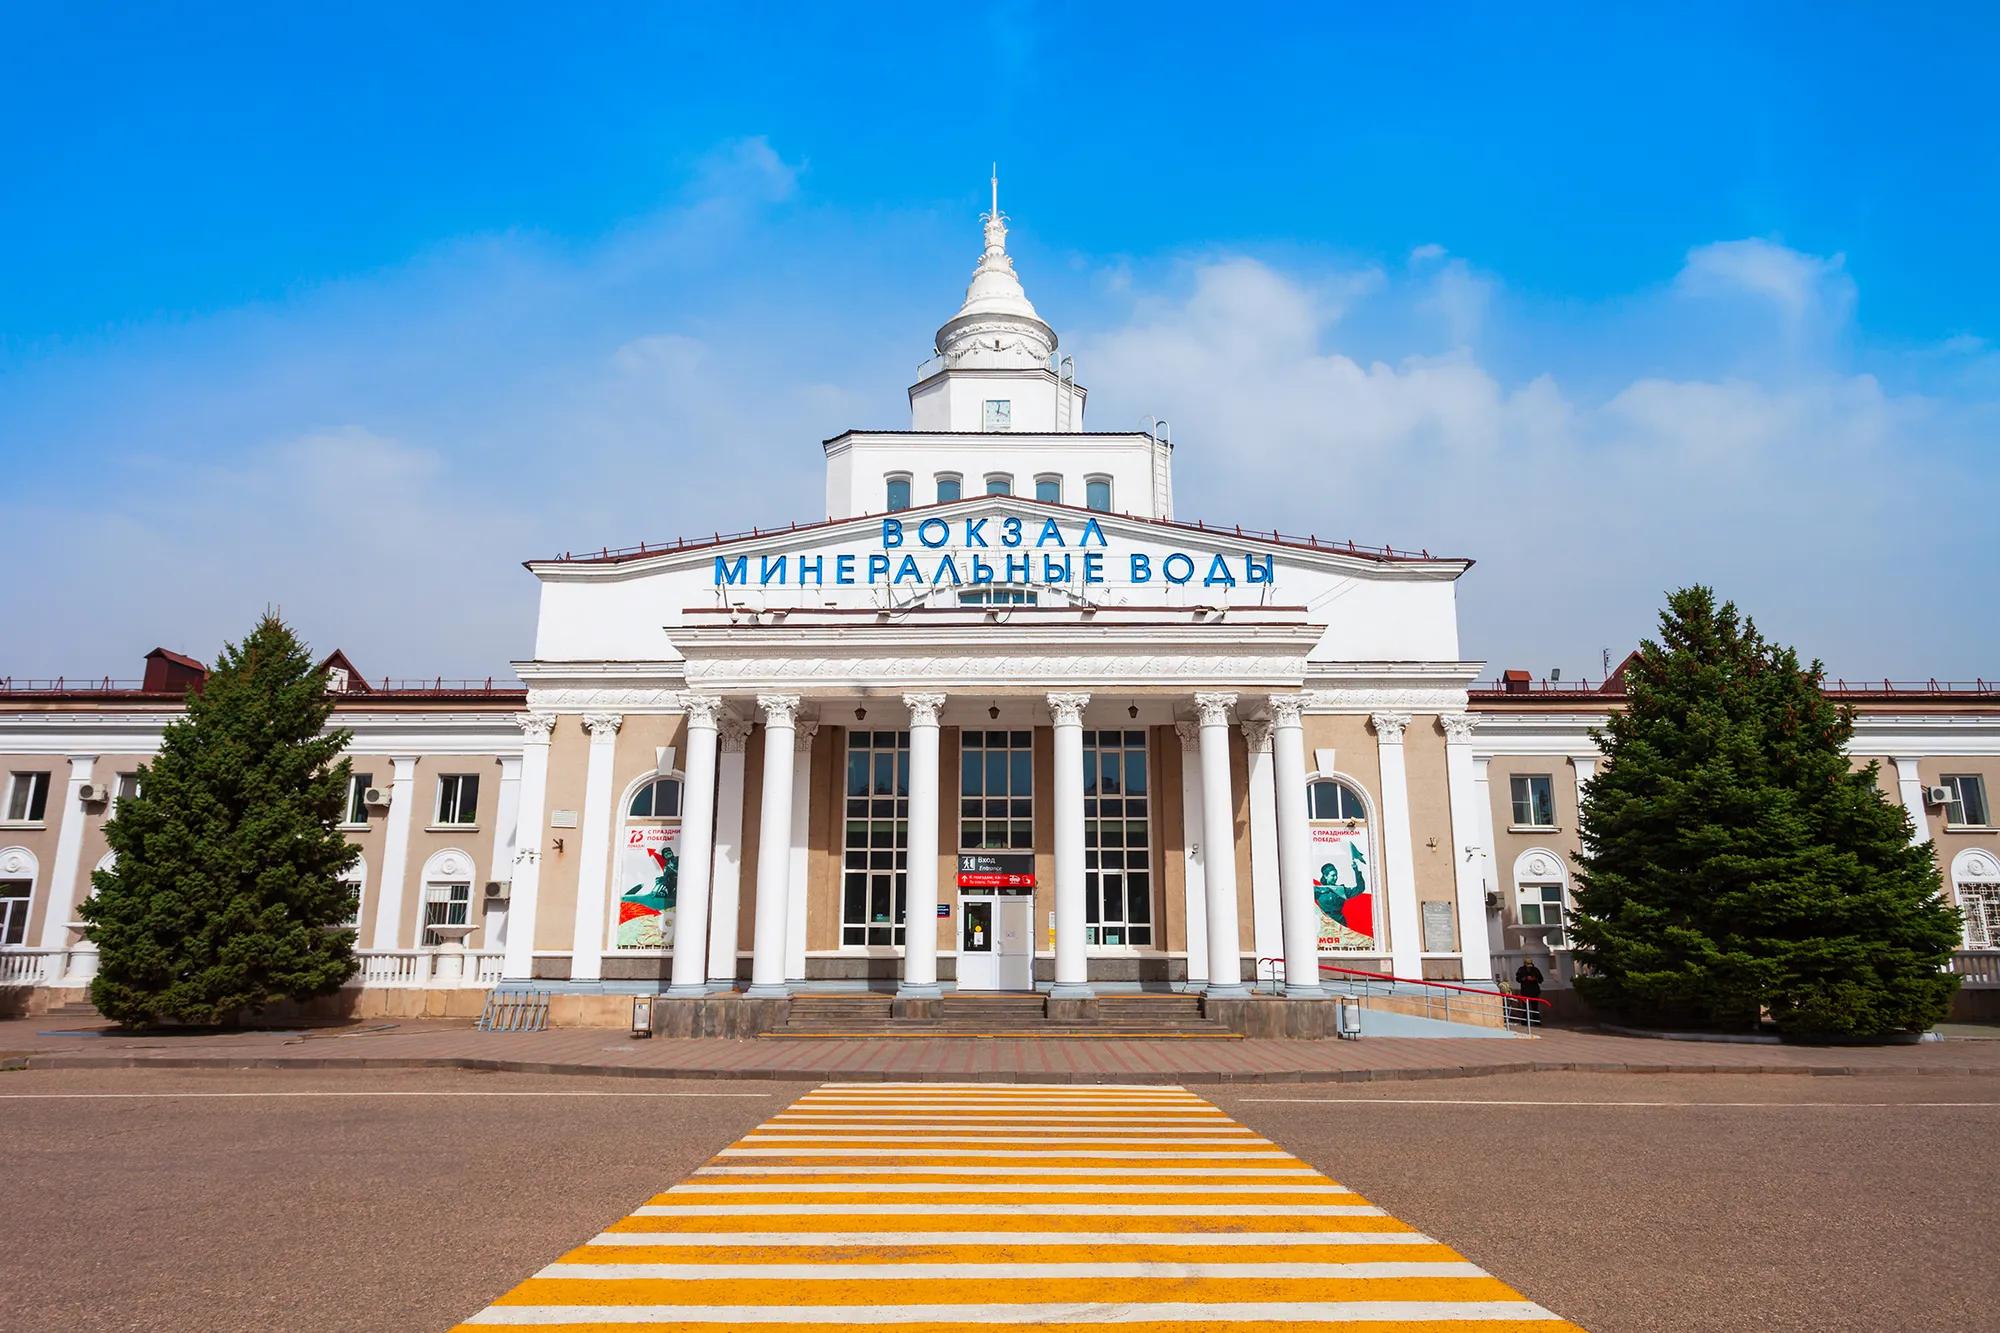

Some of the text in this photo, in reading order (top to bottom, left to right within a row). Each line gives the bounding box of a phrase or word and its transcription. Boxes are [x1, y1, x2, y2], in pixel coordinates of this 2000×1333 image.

[882, 517, 1108, 548] ВОКЗАЛ
[714, 552, 1274, 588] МИНЕРАЛЬНЫЕ ВОДЫ
[977, 856, 995, 864] Вход
